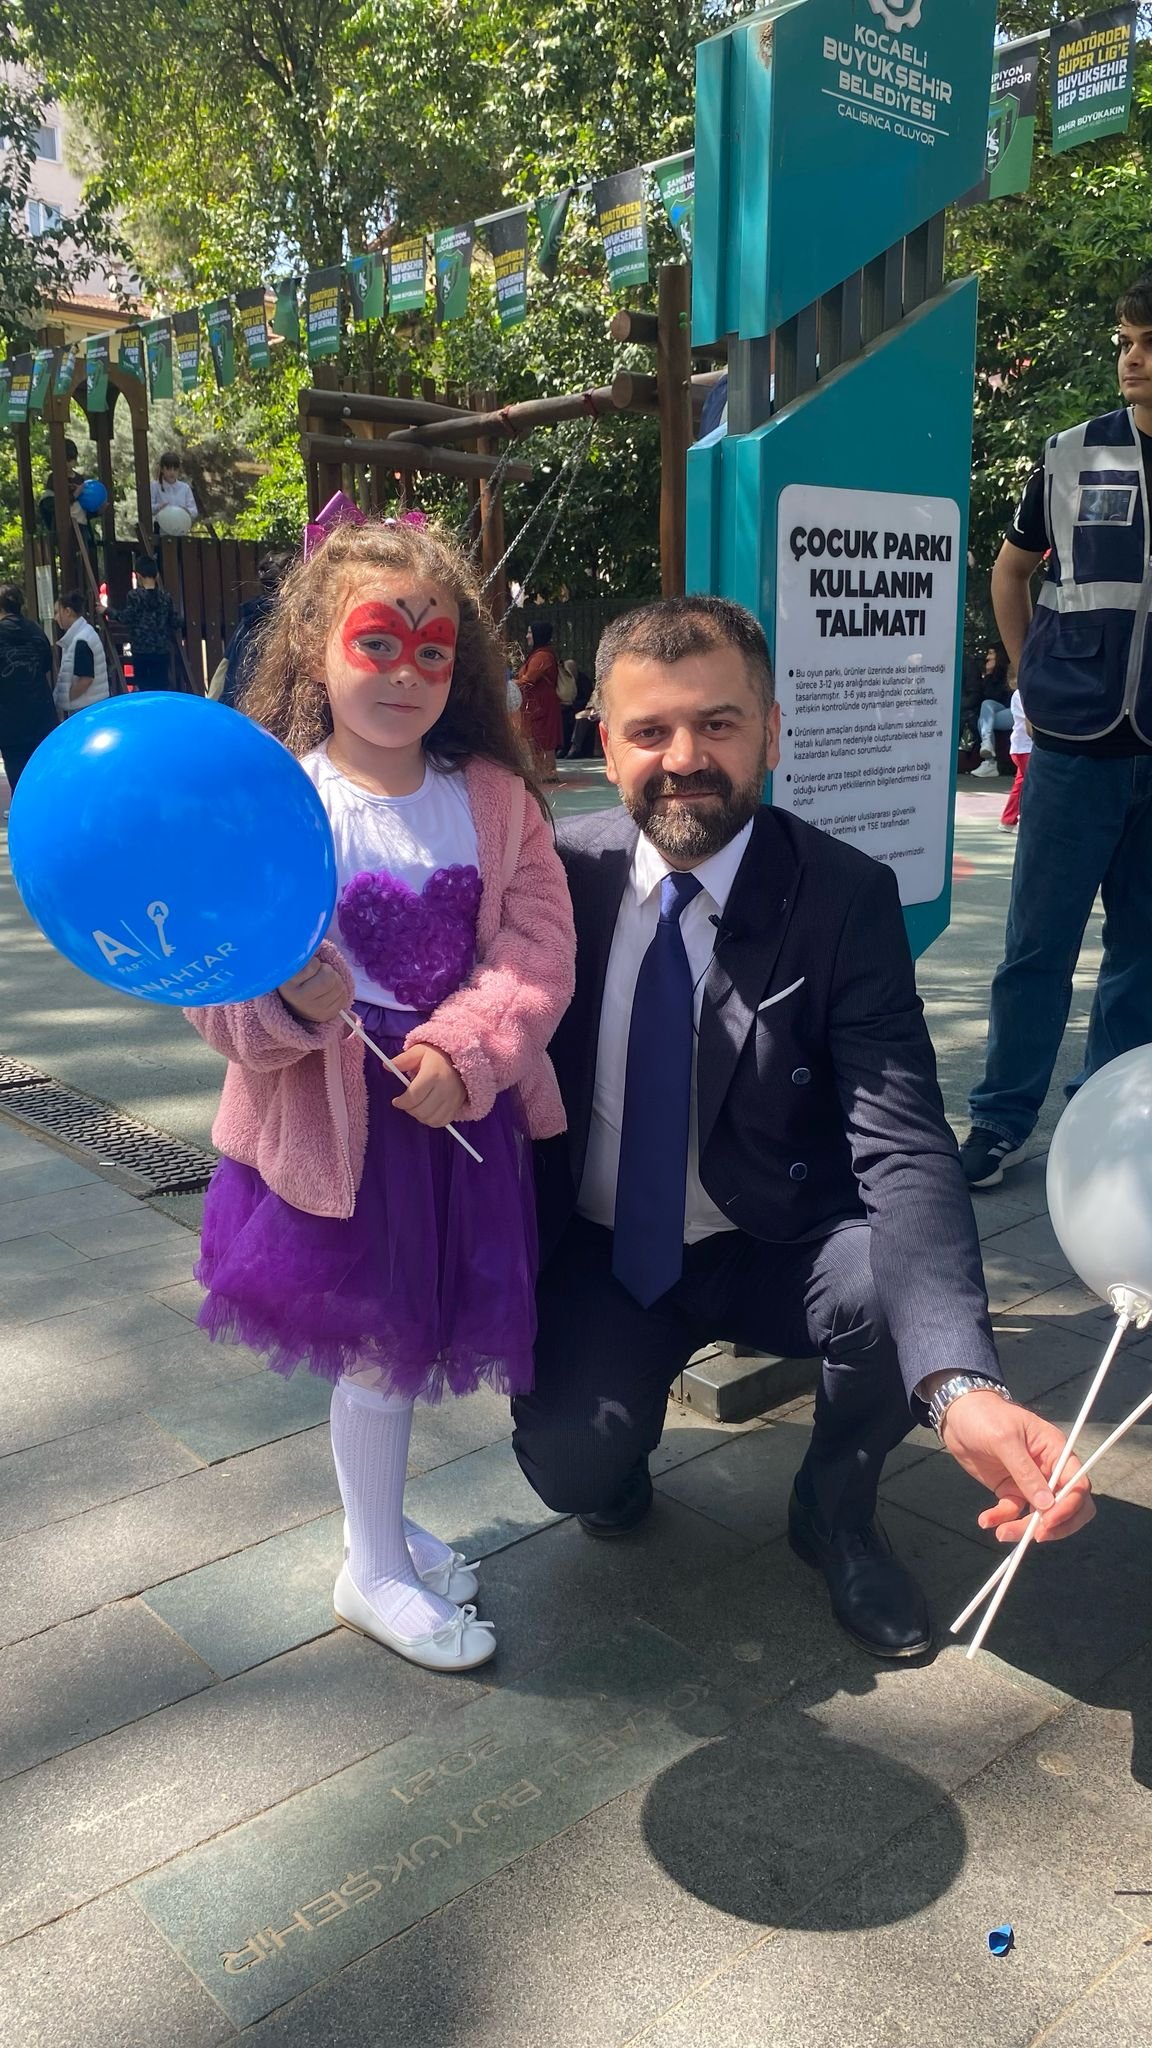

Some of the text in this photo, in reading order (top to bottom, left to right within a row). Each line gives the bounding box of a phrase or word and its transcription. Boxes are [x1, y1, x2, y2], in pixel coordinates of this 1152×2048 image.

[854, 23, 928, 69] KOCAELİ
[1058, 24, 1131, 61] AMATÖRDEN
[823, 35, 953, 104] BÜYÜKŞEHİR
[991, 64, 1023, 83] PİYON
[1057, 58, 1128, 94] BÜYÜKŞEHİR
[1058, 52, 1094, 78] SÜPER
[839, 69, 936, 121] BELEDİYESİ
[1057, 75, 1127, 110] HEP SENİNLE
[838, 103, 936, 147] ÇALIŞINCA OLUYOR
[790, 526, 952, 562] ÇOCUK PARKI
[810, 568, 933, 598] KULLANIM
[816, 602, 926, 637] TALİMATI
[795, 669, 806, 678] Bu
[806, 669, 823, 679] oyun
[844, 666, 866, 676] ürünler
[867, 665, 894, 675] üzerinde
[895, 665, 907, 674] aksi
[908, 663, 946, 674] belirtilmediği
[795, 675, 925, 690] sürece 3-12 yaş aralığındaki kullanıcılar için
[843, 690, 855, 699] 3-6
[856, 690, 867, 699] yaş
[867, 688, 902, 698] aralığındaki
[795, 703, 820, 715] yetişkin
[821, 701, 860, 712] kontrolünde
[794, 726, 825, 737] Ürünlerin
[854, 723, 876, 733] dışında
[877, 721, 904, 731] kullanımı
[794, 739, 813, 749] Hatalı
[814, 737, 842, 747] kullanım
[842, 735, 873, 745] nedeniyle
[874, 731, 918, 743] oluşturabilecek
[919, 730, 935, 739] hasar
[794, 750, 829, 760] kazalardan
[830, 748, 856, 757] kullanıcı
[793, 762, 931, 784] Ürünlerde arıza tespit edildiğinde parkın bağlı
[793, 785, 816, 796] olduğu
[817, 783, 838, 792] kurum
[877, 774, 920, 786] bilgilendirmesi
[920, 773, 932, 781] rica
[820, 818, 833, 826] tüm
[834, 814, 857, 824] ürünler
[857, 810, 891, 821] uluslararası
[891, 805, 917, 818] güvenlik
[867, 821, 879, 831] TSE
[880, 818, 910, 829] tarafından
[92, 930, 142, 966] A
[131, 941, 240, 997] ANAHTAR
